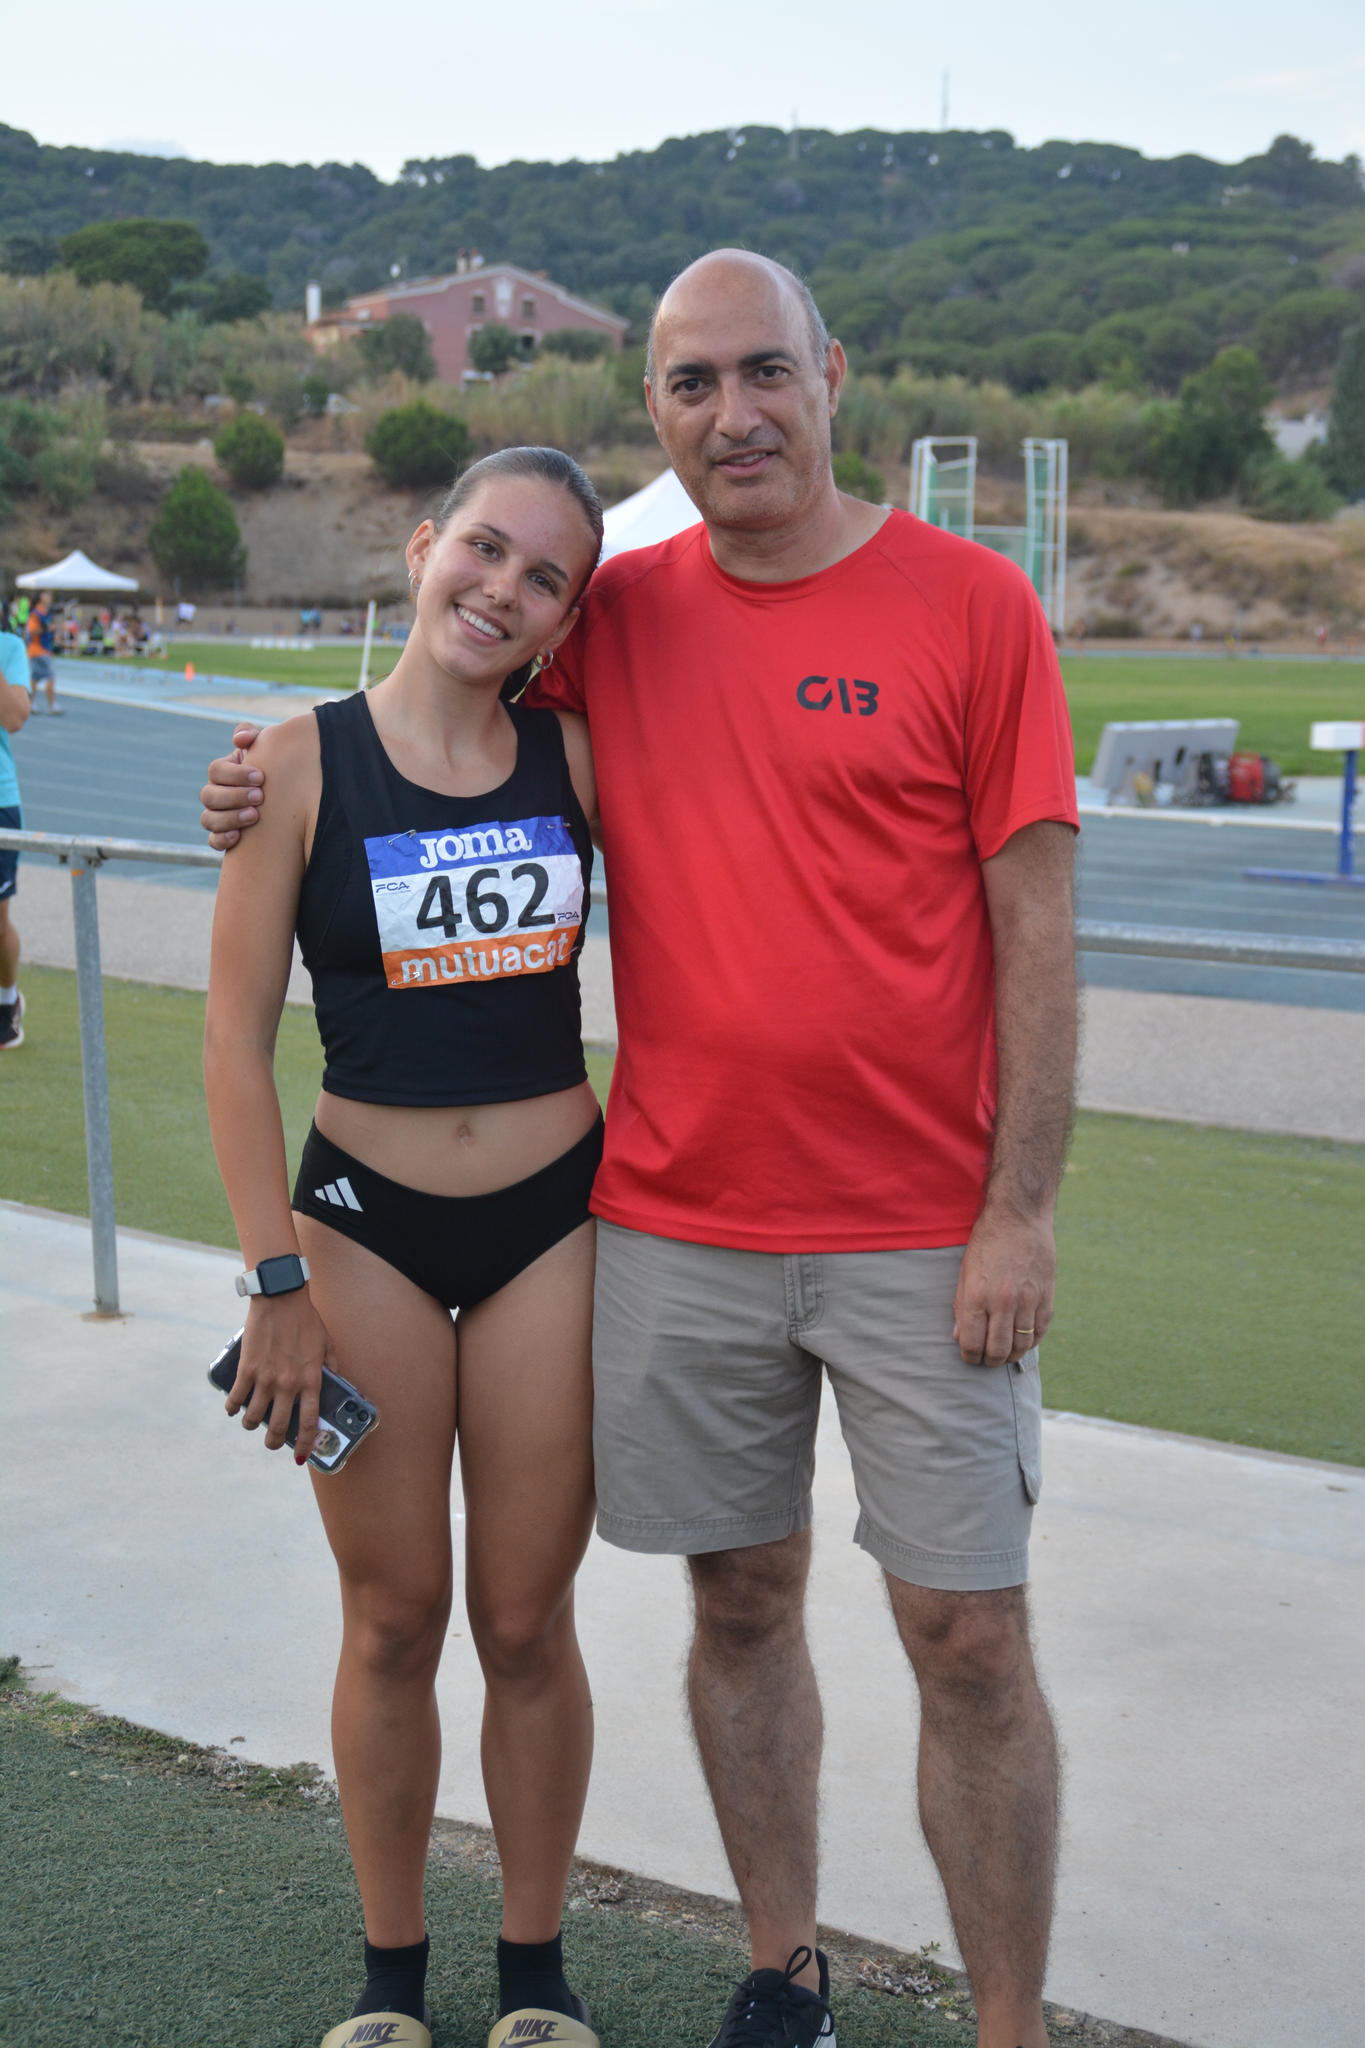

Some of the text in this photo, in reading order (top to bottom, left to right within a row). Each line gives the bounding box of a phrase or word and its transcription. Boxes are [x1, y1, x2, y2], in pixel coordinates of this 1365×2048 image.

[416, 863, 556, 938] 462
[401, 932, 568, 983] mutuacat
[350, 2022, 400, 2043] NIKE
[508, 2019, 559, 2039] NIKE
